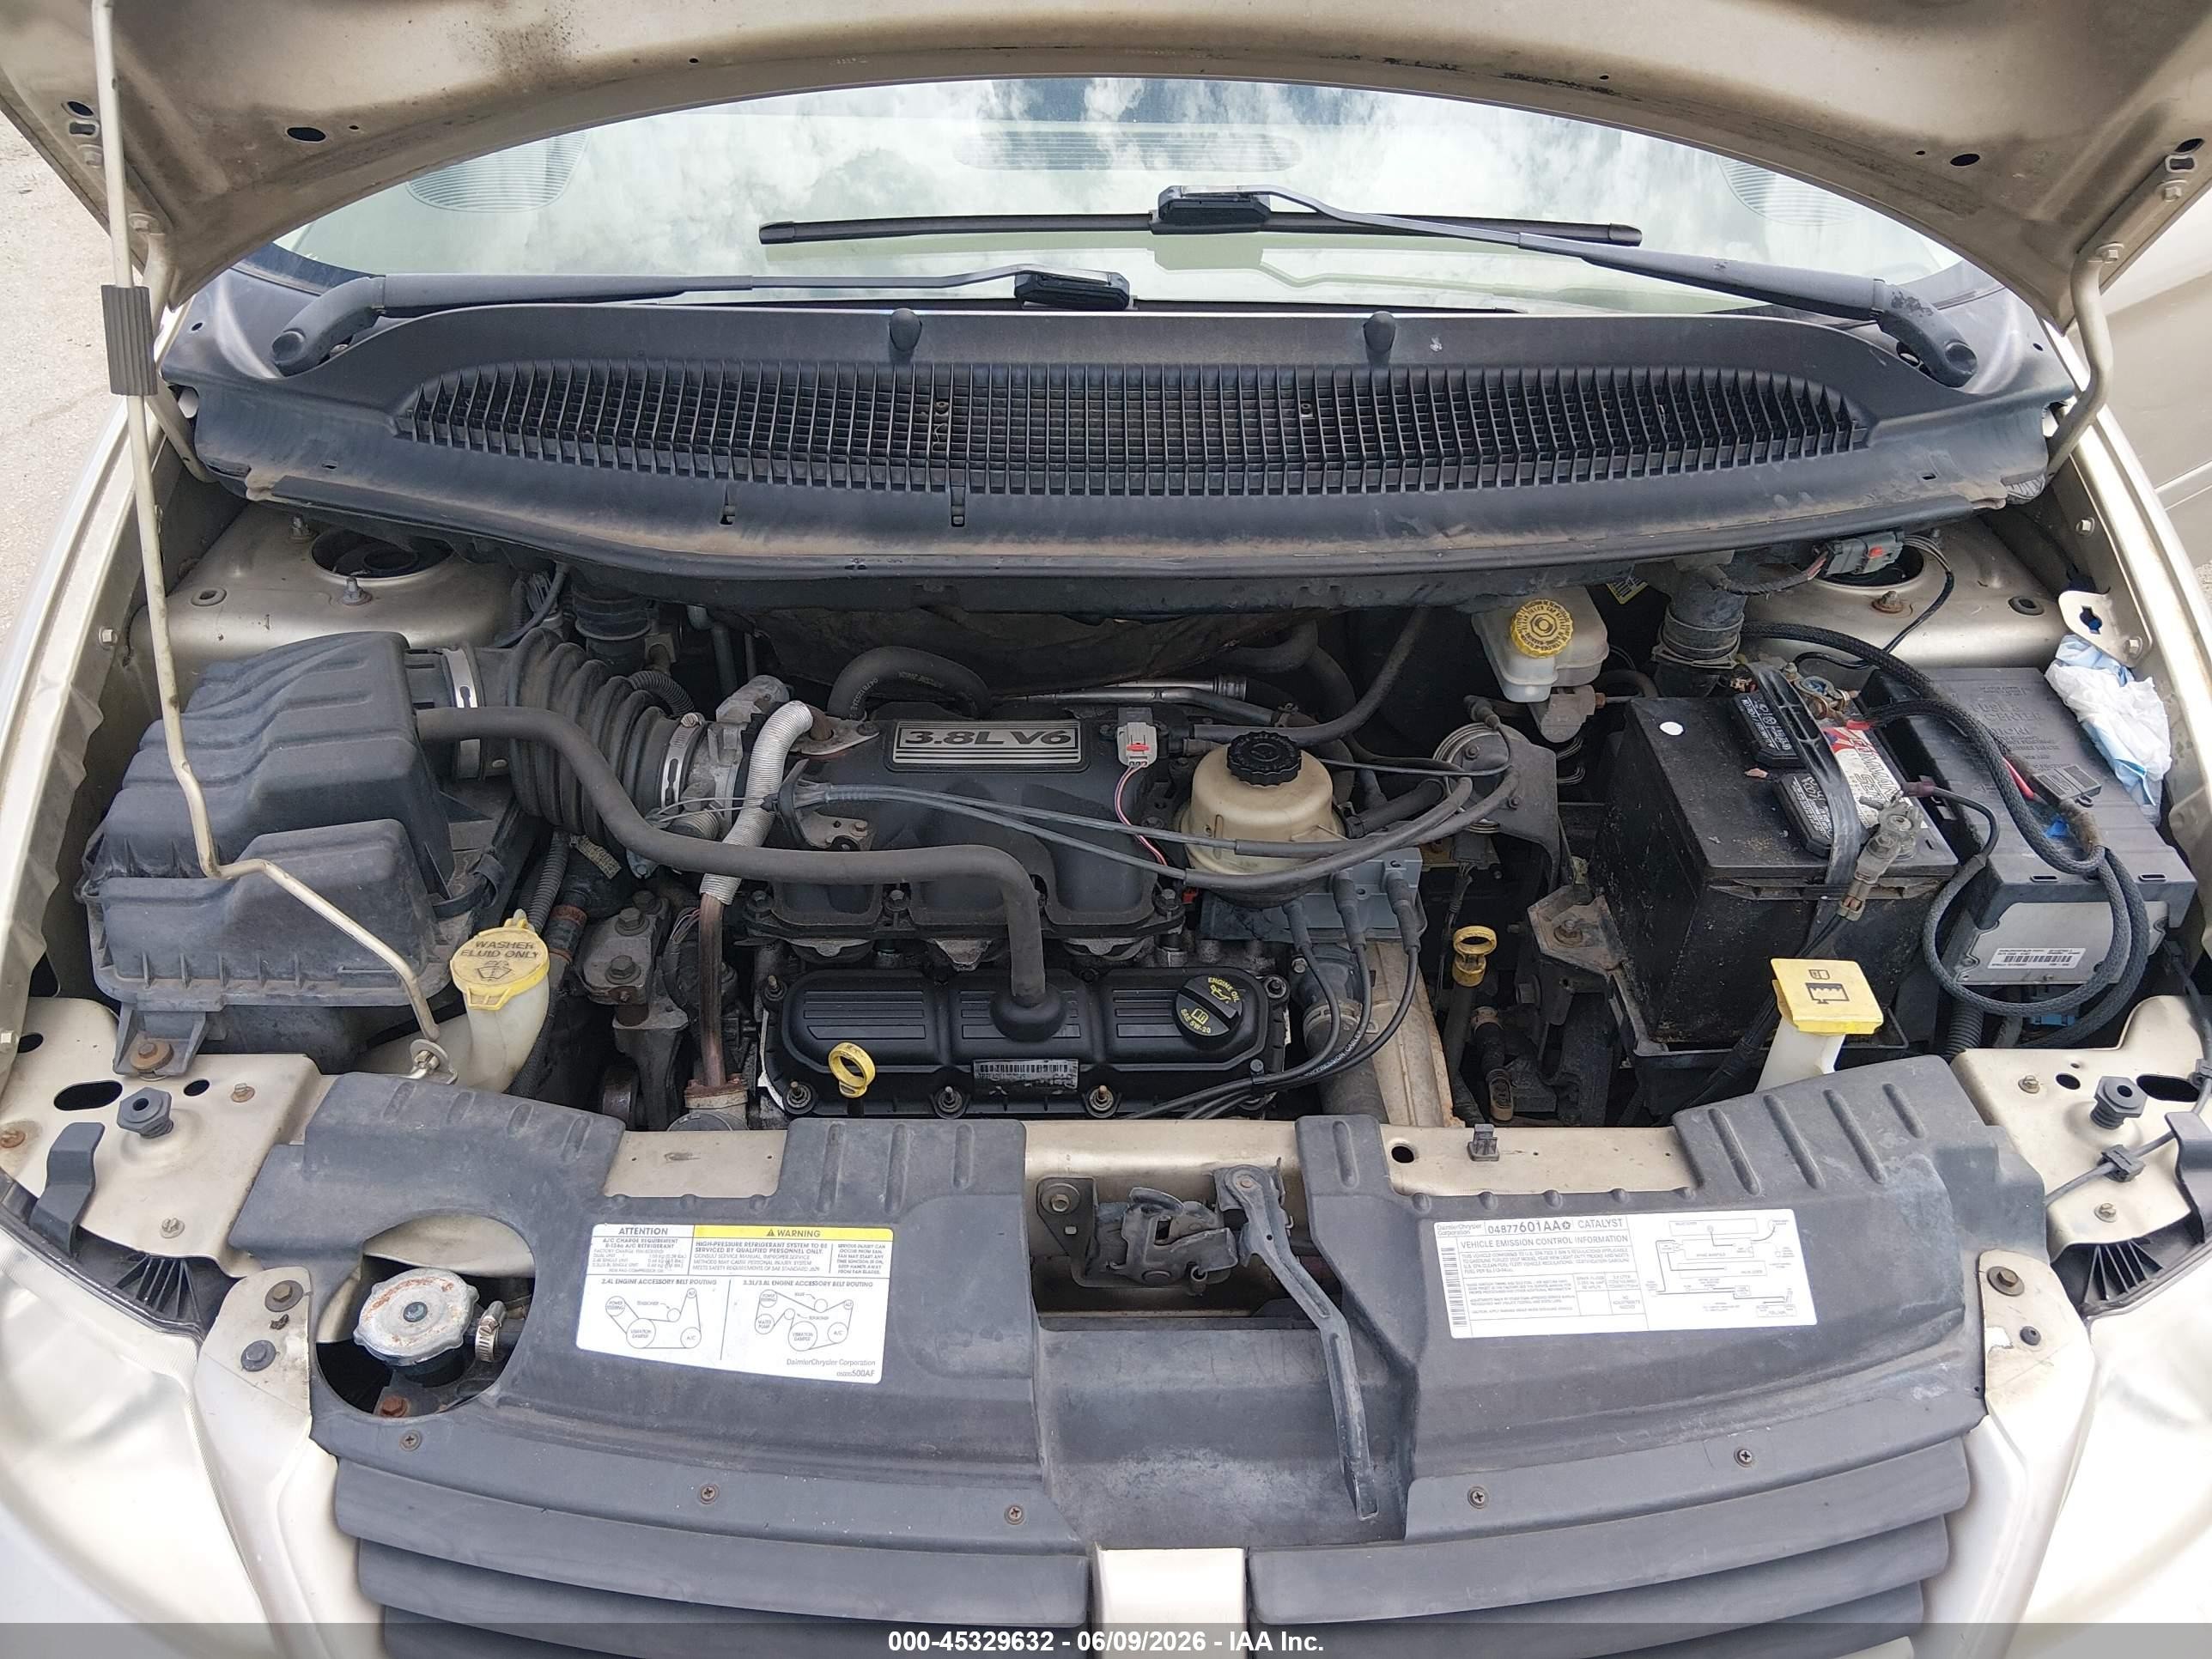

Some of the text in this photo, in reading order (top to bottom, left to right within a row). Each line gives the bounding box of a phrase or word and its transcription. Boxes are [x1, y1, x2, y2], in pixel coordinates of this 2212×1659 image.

[905, 730, 1072, 744] 3.8L V6
[1849, 736, 1899, 802] COMMAN
[475, 940, 534, 949] WASHER
[460, 949, 539, 958] FLUID ONLY
[1207, 976, 1241, 1003] ENGINE OIL
[1181, 1008, 1211, 1034] SAE 5W-20
[1487, 1220, 1561, 1234] 04877601AA
[1577, 1218, 1623, 1229] CATALYST
[1461, 1235, 1628, 1249] VEHICLE EMISSION CONTROL INFORMATION
[787, 1358, 837, 1367] DaimlerChrysler
